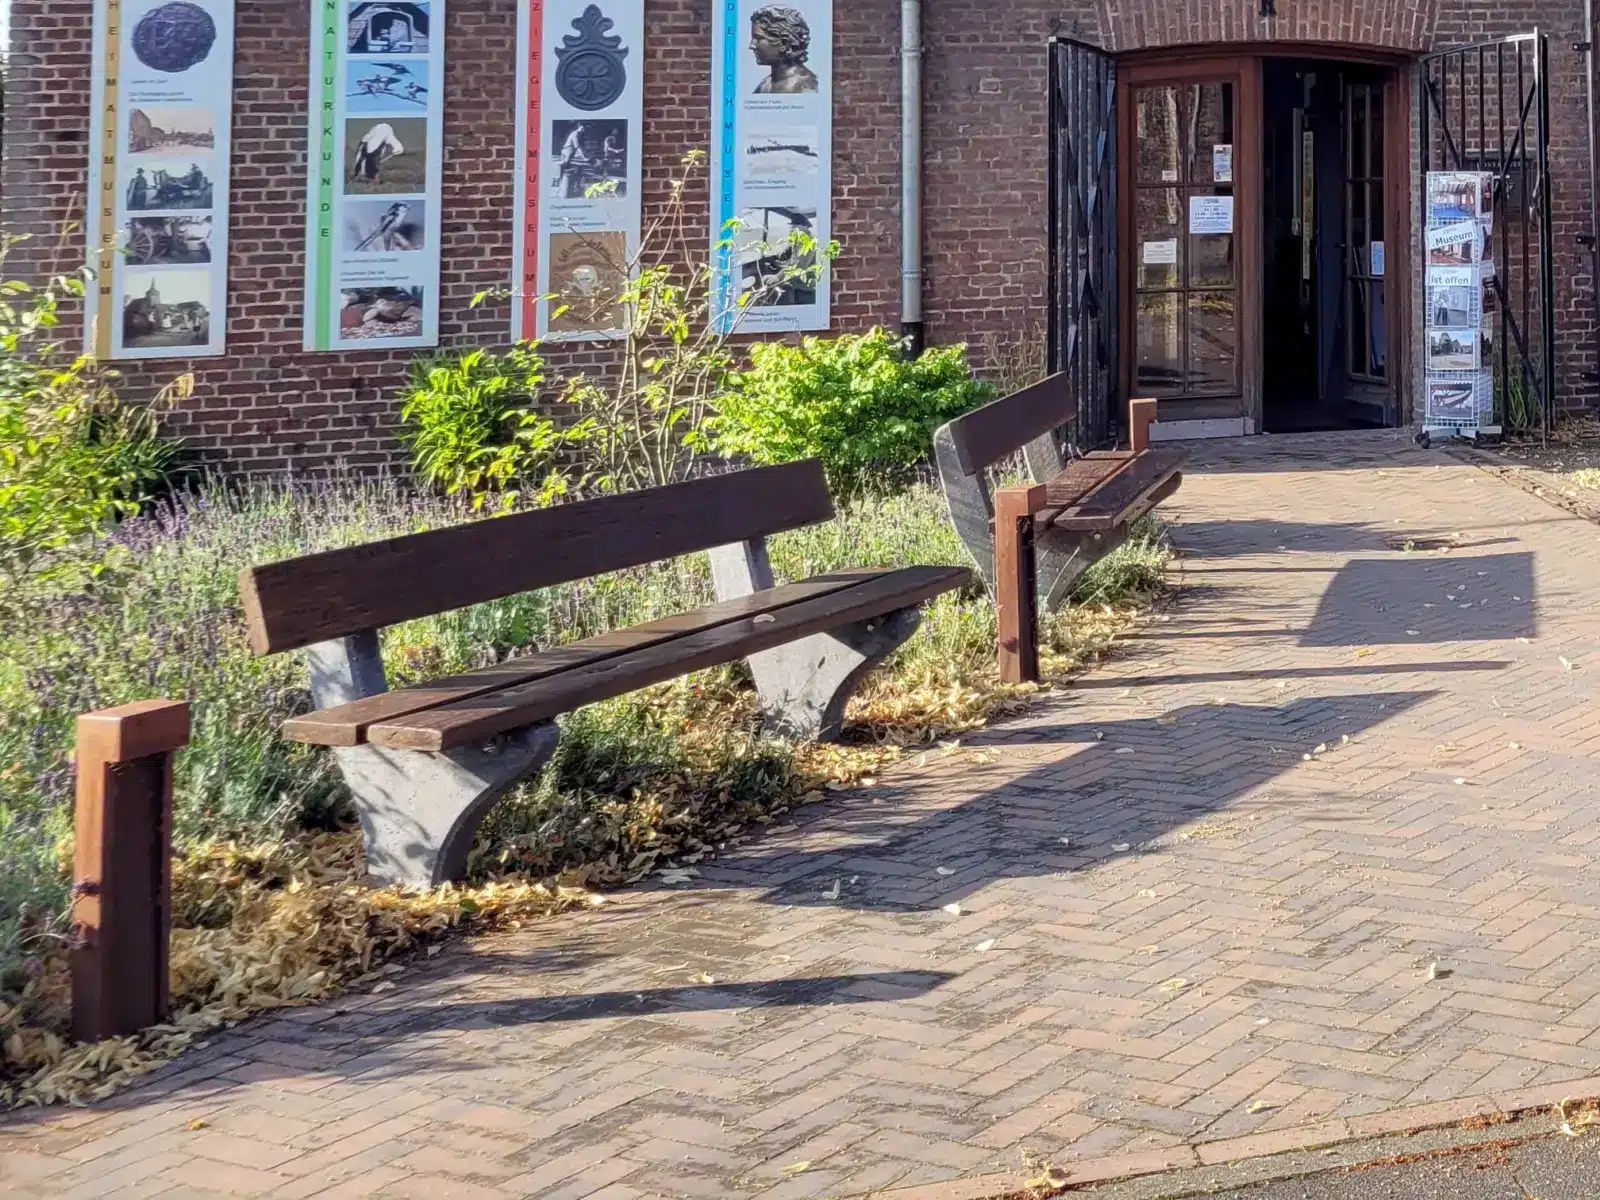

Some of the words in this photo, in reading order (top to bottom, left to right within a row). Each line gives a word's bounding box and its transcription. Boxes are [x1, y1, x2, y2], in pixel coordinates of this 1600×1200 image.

[101, 0, 119, 294] HEIMATMUSEUM
[321, 1, 335, 237] NATURKUNDE
[526, 2, 540, 282] ZIEGELMUSEUM
[1435, 231, 1473, 246] Museum
[1444, 275, 1469, 284] offen
